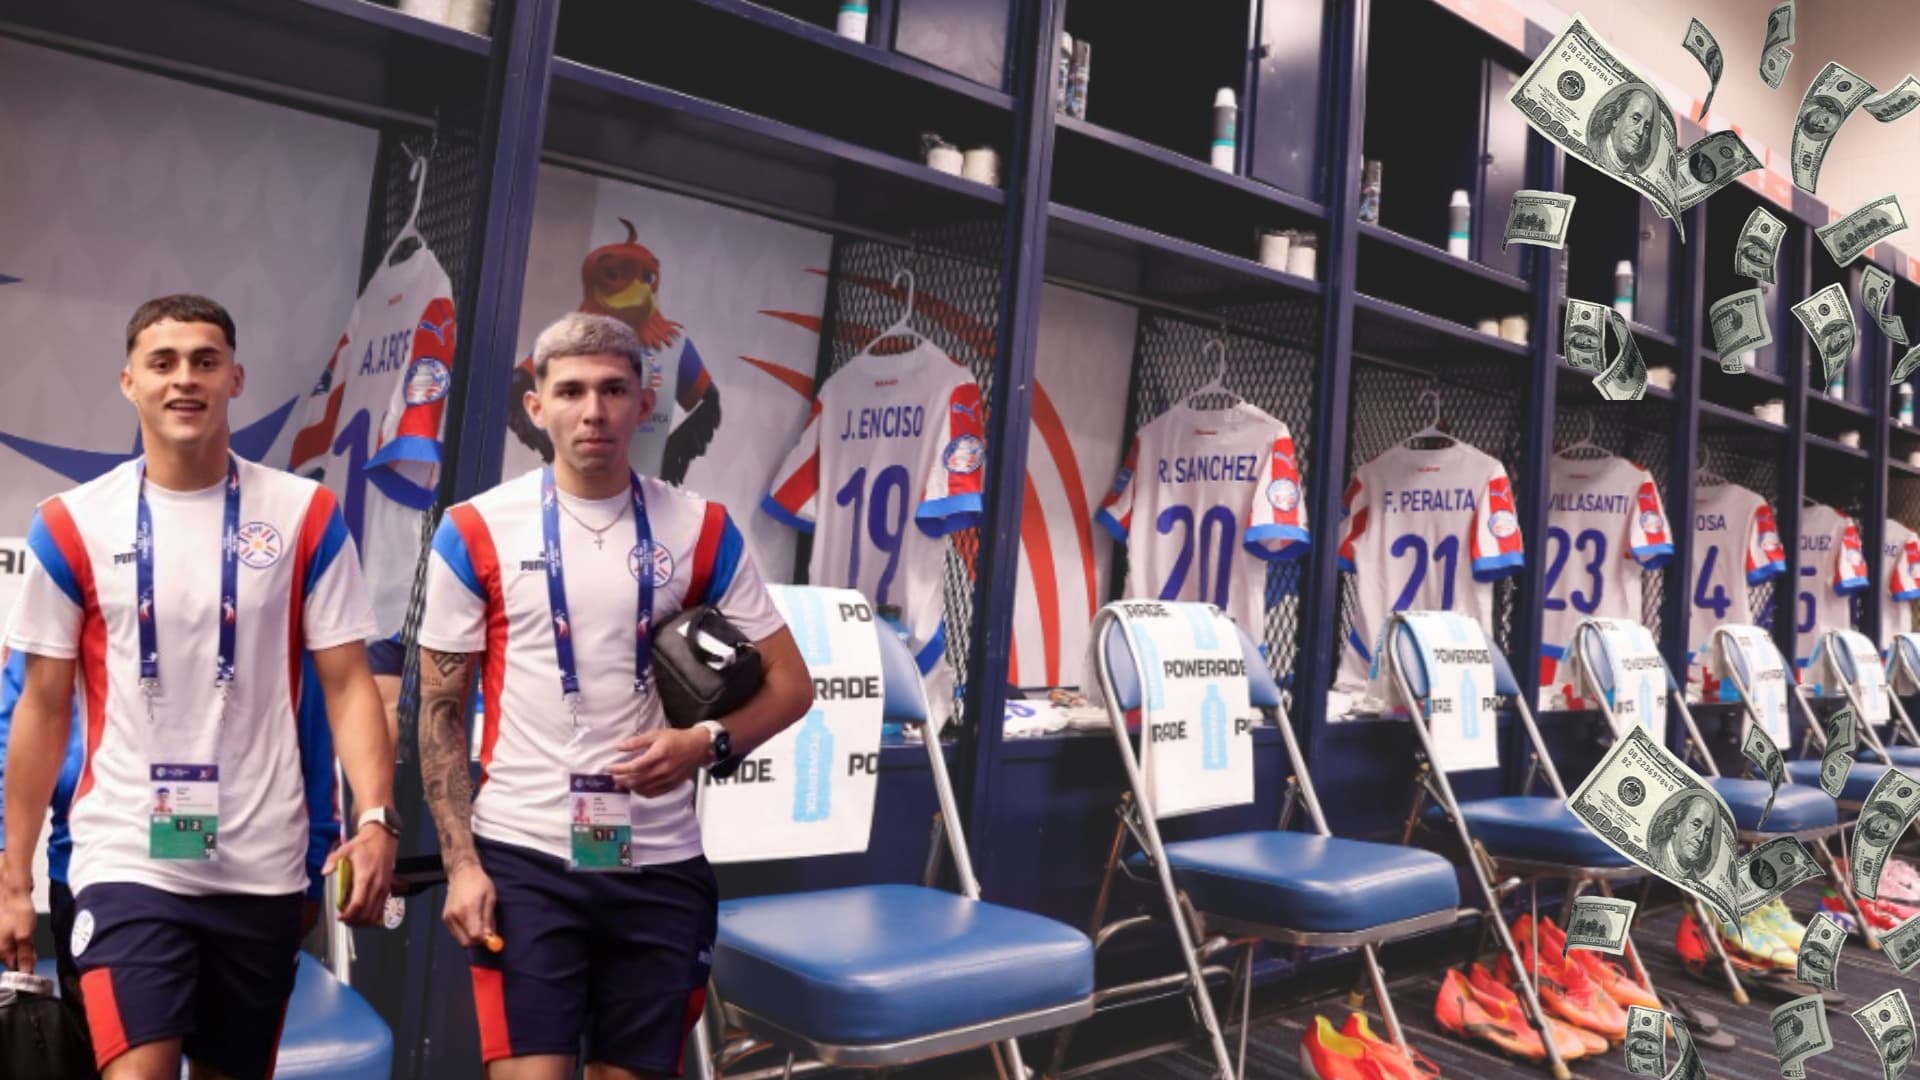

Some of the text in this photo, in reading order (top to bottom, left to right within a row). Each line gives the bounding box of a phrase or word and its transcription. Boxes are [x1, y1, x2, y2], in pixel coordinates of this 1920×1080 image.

[836, 464, 910, 609] 19
[1156, 504, 1236, 611] 20
[1390, 533, 1460, 612] 21
[1543, 526, 1607, 615] 23
